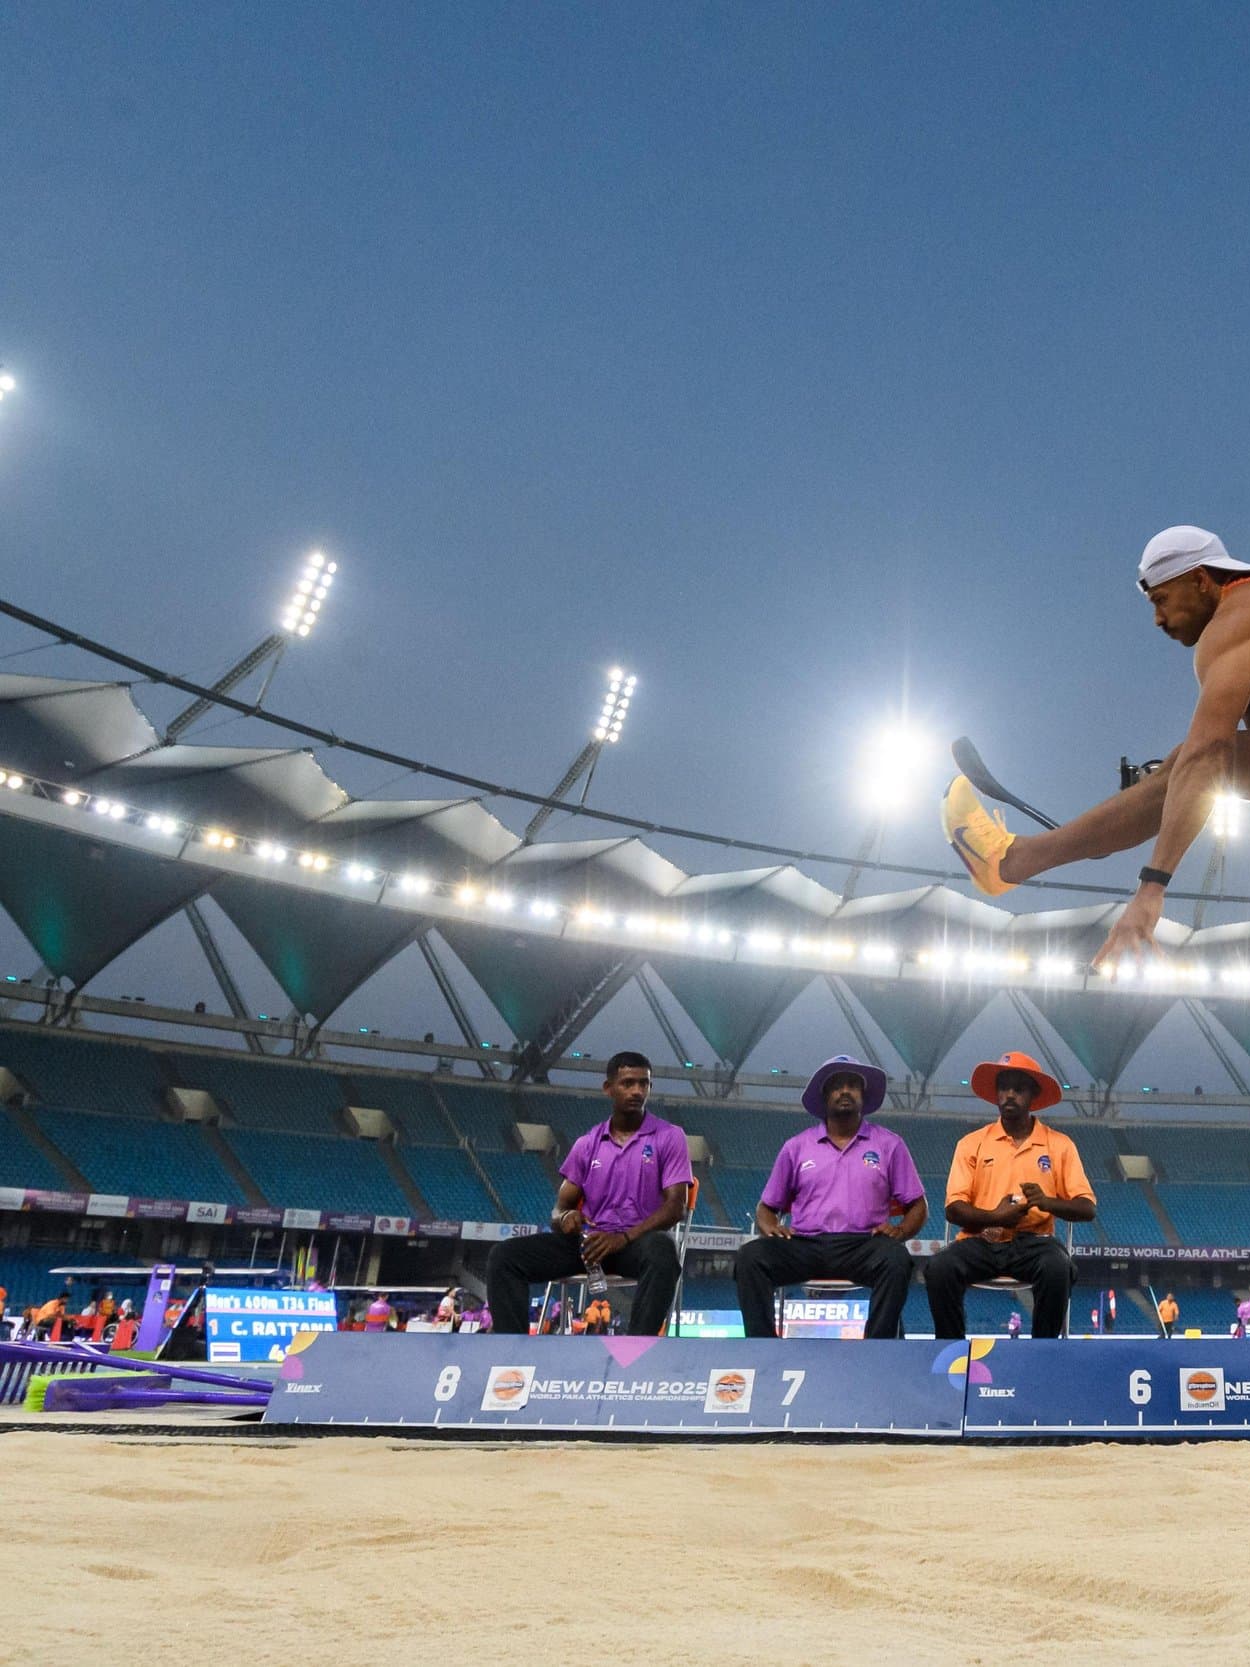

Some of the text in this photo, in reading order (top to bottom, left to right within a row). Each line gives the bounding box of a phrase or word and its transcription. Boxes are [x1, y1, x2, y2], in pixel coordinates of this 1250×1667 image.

[197, 1207, 218, 1219] SAI
[1069, 1247, 1101, 1257] DELHI
[1104, 1247, 1131, 1258] 2025
[1133, 1248, 1176, 1259] WORLD
[1177, 1249, 1208, 1259] PARA
[207, 1294, 241, 1309] Men's
[245, 1296, 278, 1310] 400m
[308, 1298, 334, 1312] Final
[776, 1303, 864, 1320] HAEFER L
[208, 1319, 218, 1336] 1
[231, 1321, 248, 1336] C.
[285, 1383, 323, 1393] Vinex
[434, 1366, 462, 1402] 8
[530, 1380, 585, 1393] NEW
[588, 1381, 653, 1395] DELHI
[656, 1381, 707, 1395] 2025
[781, 1370, 806, 1406] 7
[1129, 1369, 1152, 1405] 6
[635, 1394, 706, 1402] CHAMPIONSHIPS
[979, 1387, 1015, 1398] Vinex
